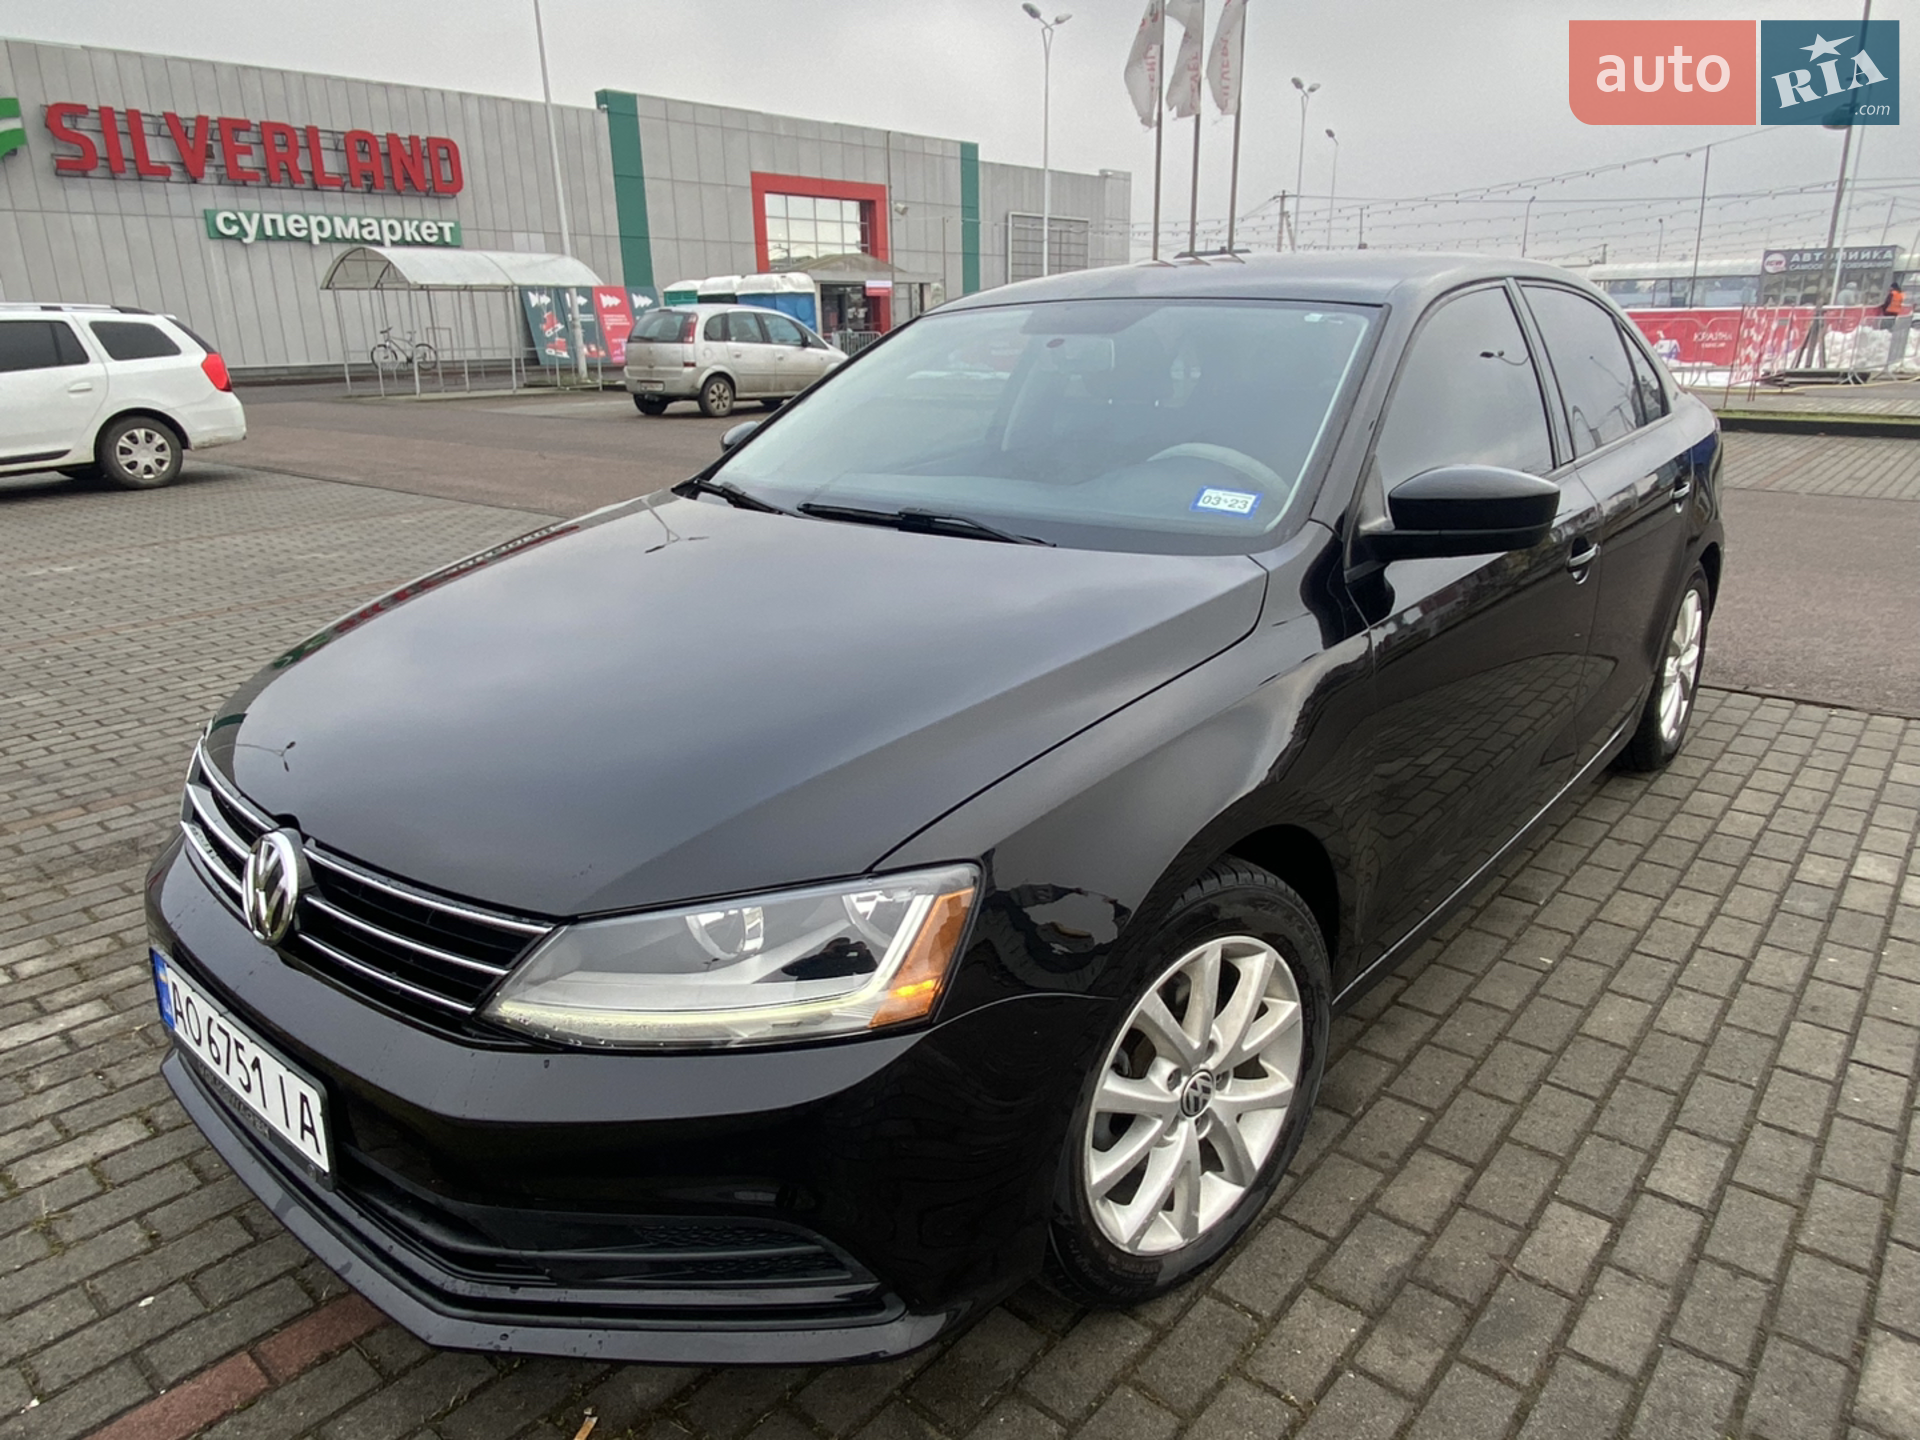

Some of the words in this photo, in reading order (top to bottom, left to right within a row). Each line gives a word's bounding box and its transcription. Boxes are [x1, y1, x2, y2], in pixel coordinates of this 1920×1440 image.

[45, 102, 465, 196] SILVERLAND
[215, 210, 456, 247] супермаркет
[1202, 495, 1222, 506] 03
[1227, 498, 1249, 510] 23
[207, 1017, 268, 1110] 6751
